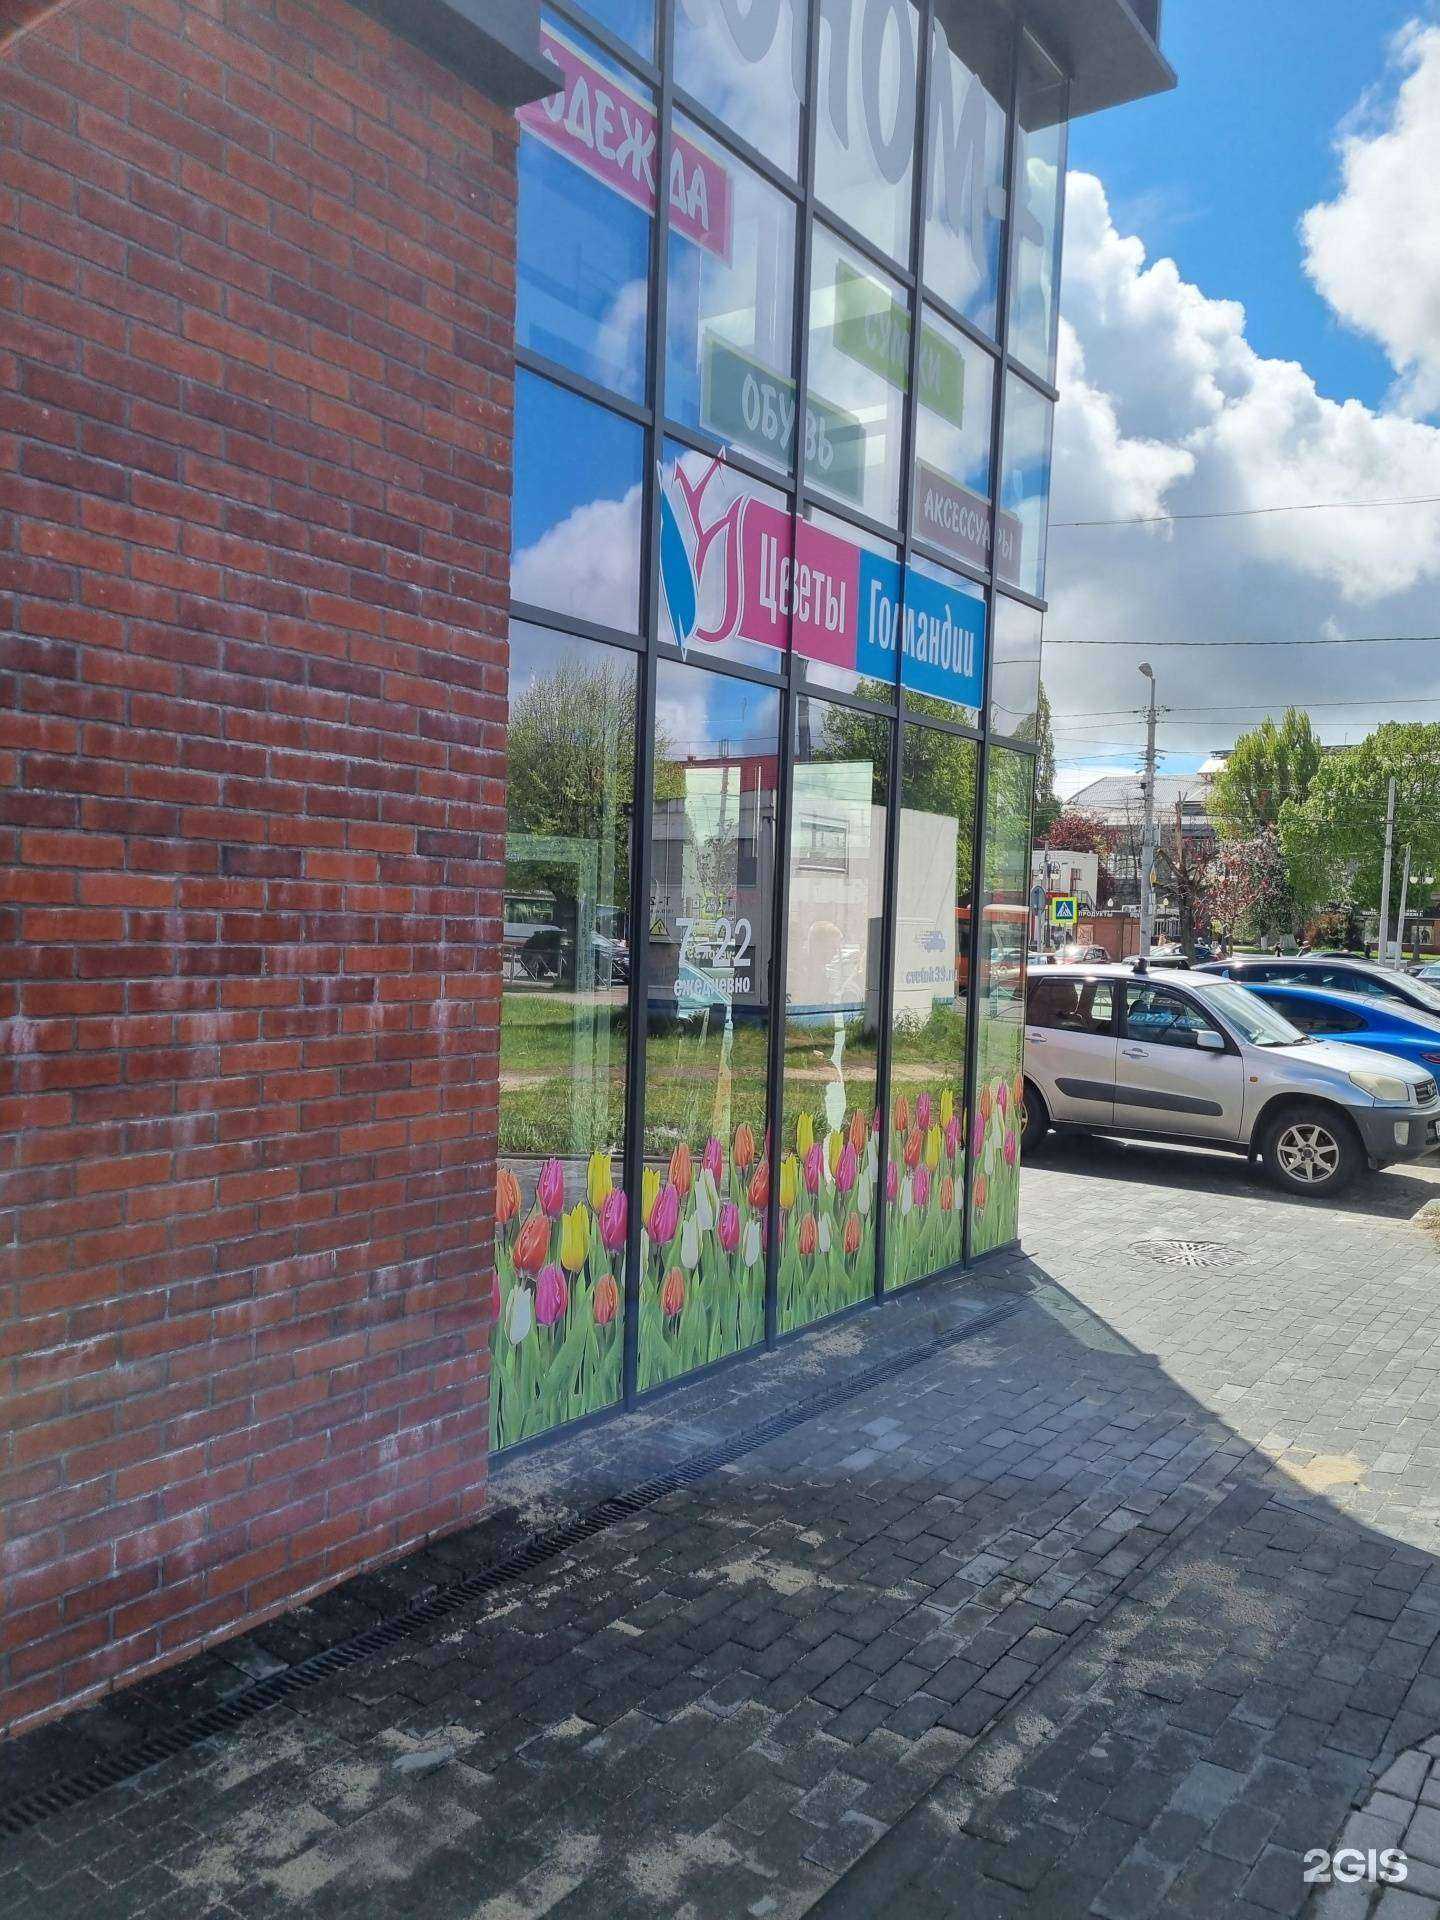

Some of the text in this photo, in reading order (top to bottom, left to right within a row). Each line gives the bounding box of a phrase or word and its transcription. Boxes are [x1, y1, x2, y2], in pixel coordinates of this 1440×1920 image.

[741, 372, 834, 470] ОБУВЬ
[759, 532, 974, 677] Цветы Голландии
